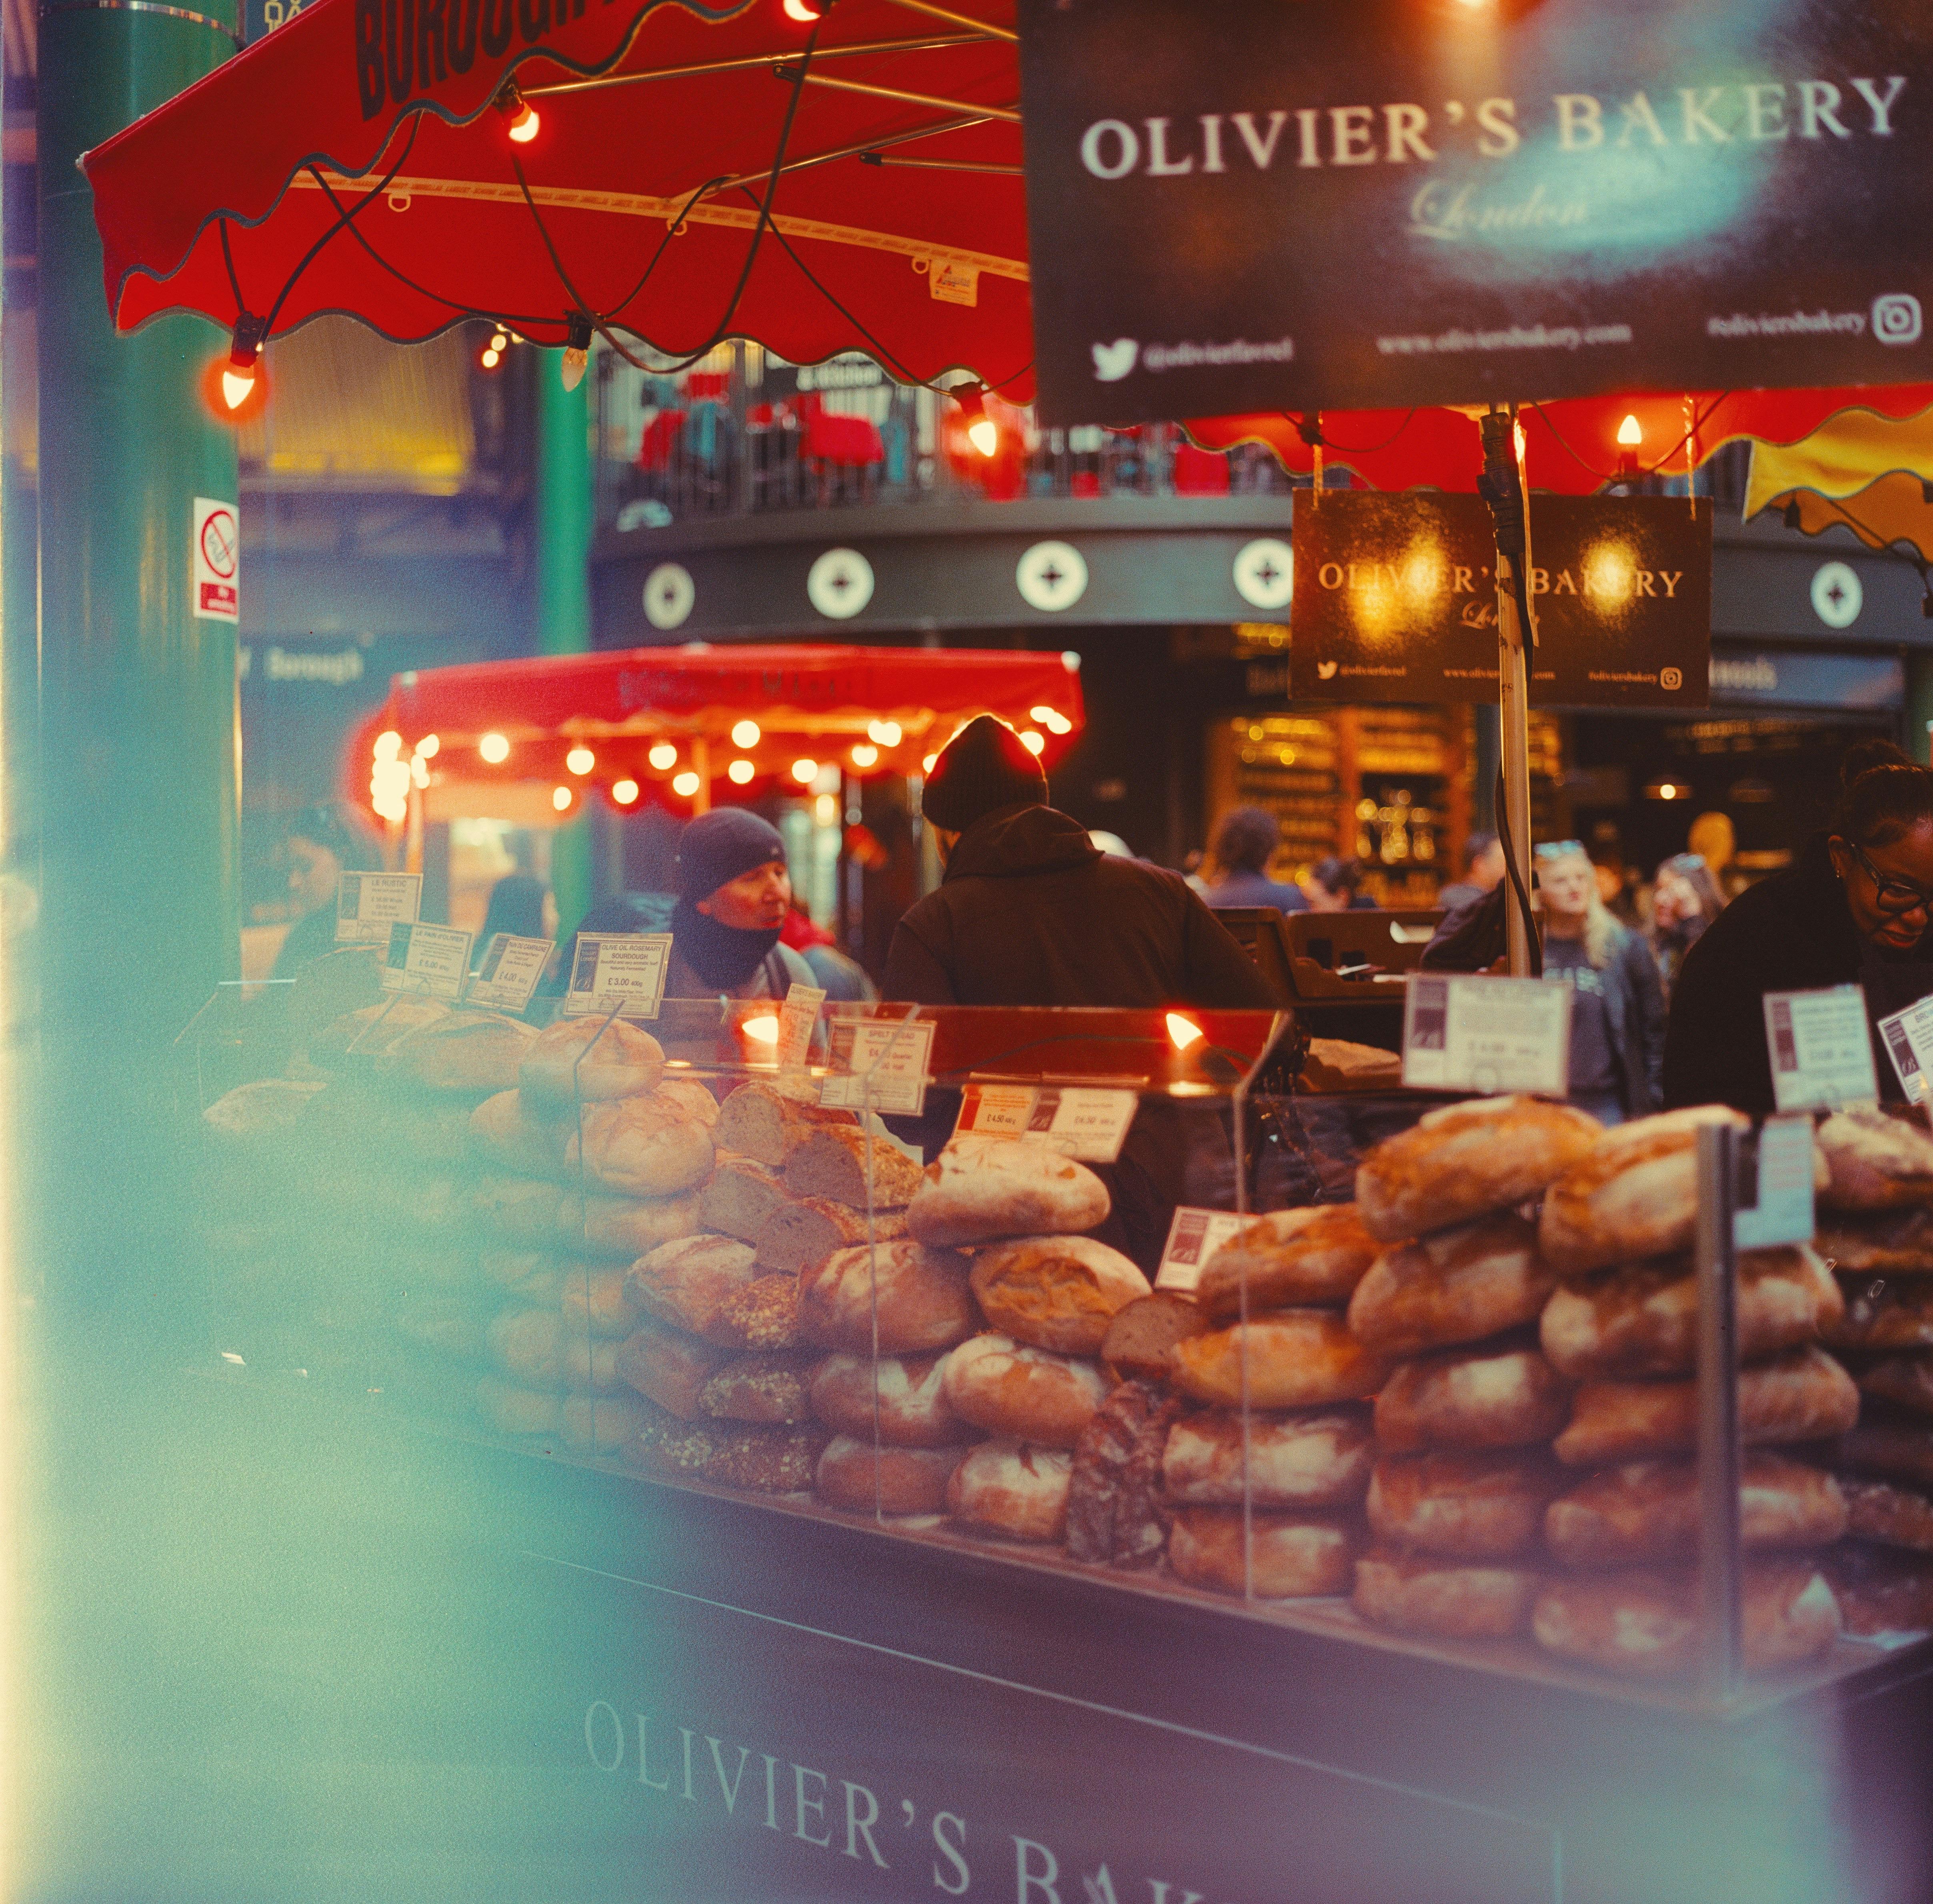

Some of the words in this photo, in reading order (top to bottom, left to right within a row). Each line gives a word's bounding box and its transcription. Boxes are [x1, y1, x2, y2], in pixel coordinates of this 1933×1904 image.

[1079, 96, 1521, 181] OLIVIER'S
[1557, 75, 1909, 153] BAKERY
[1409, 178, 1587, 239] London
[584, 1700, 971, 1895] OLIVIER'S
